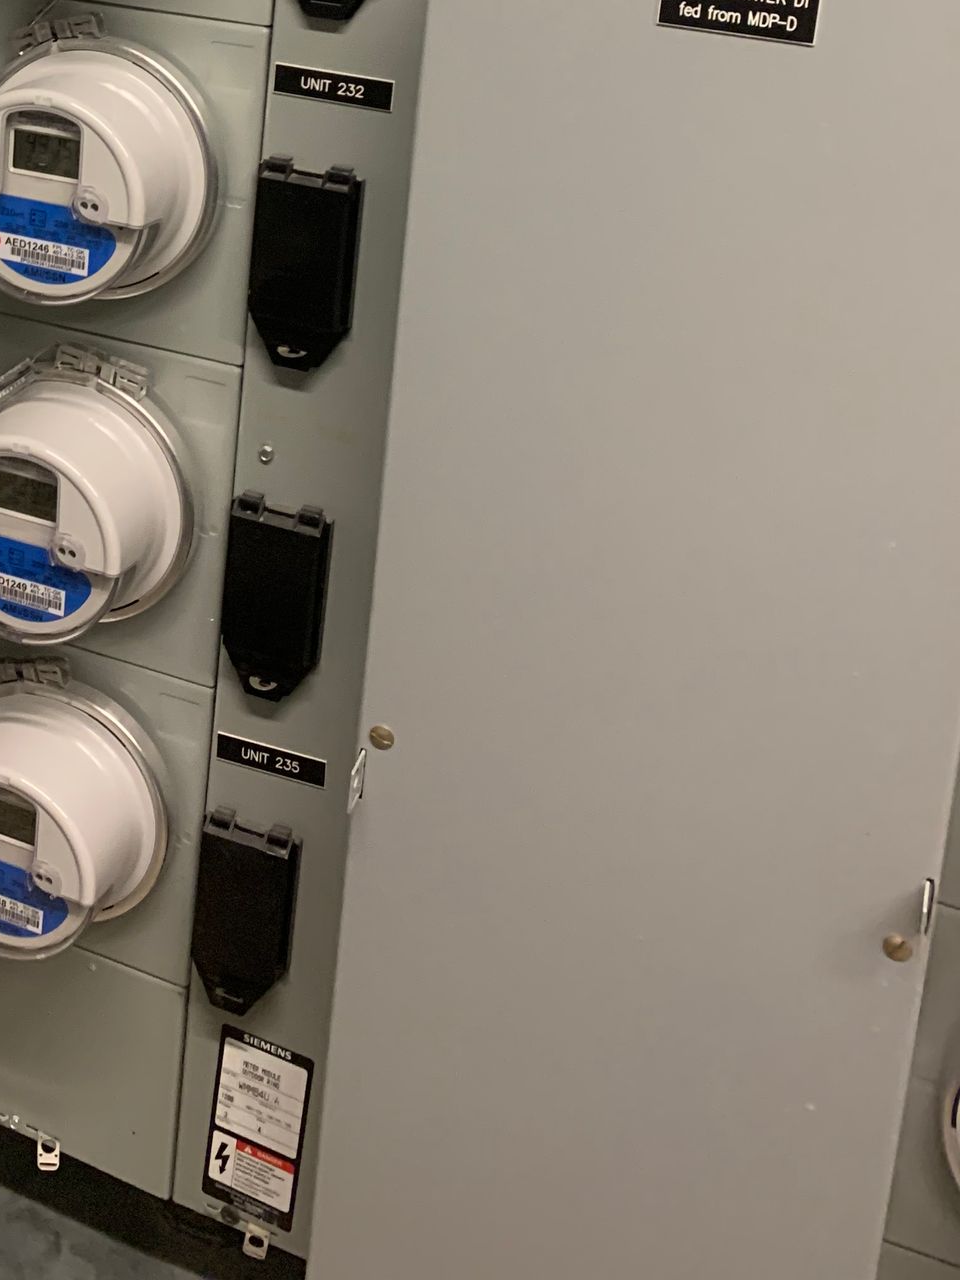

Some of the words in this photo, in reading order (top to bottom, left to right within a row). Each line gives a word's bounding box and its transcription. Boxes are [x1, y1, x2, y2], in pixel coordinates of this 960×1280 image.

[679, 1, 702, 19] fed
[707, 5, 741, 24] from
[747, 10, 798, 32] MDP-D
[300, 75, 332, 93] UNIT
[337, 81, 365, 99] 232
[4, 236, 50, 253] AED1246
[240, 746, 271, 765] UNIT
[275, 756, 300, 774] 235
[243, 1034, 292, 1060] SIEMENS
